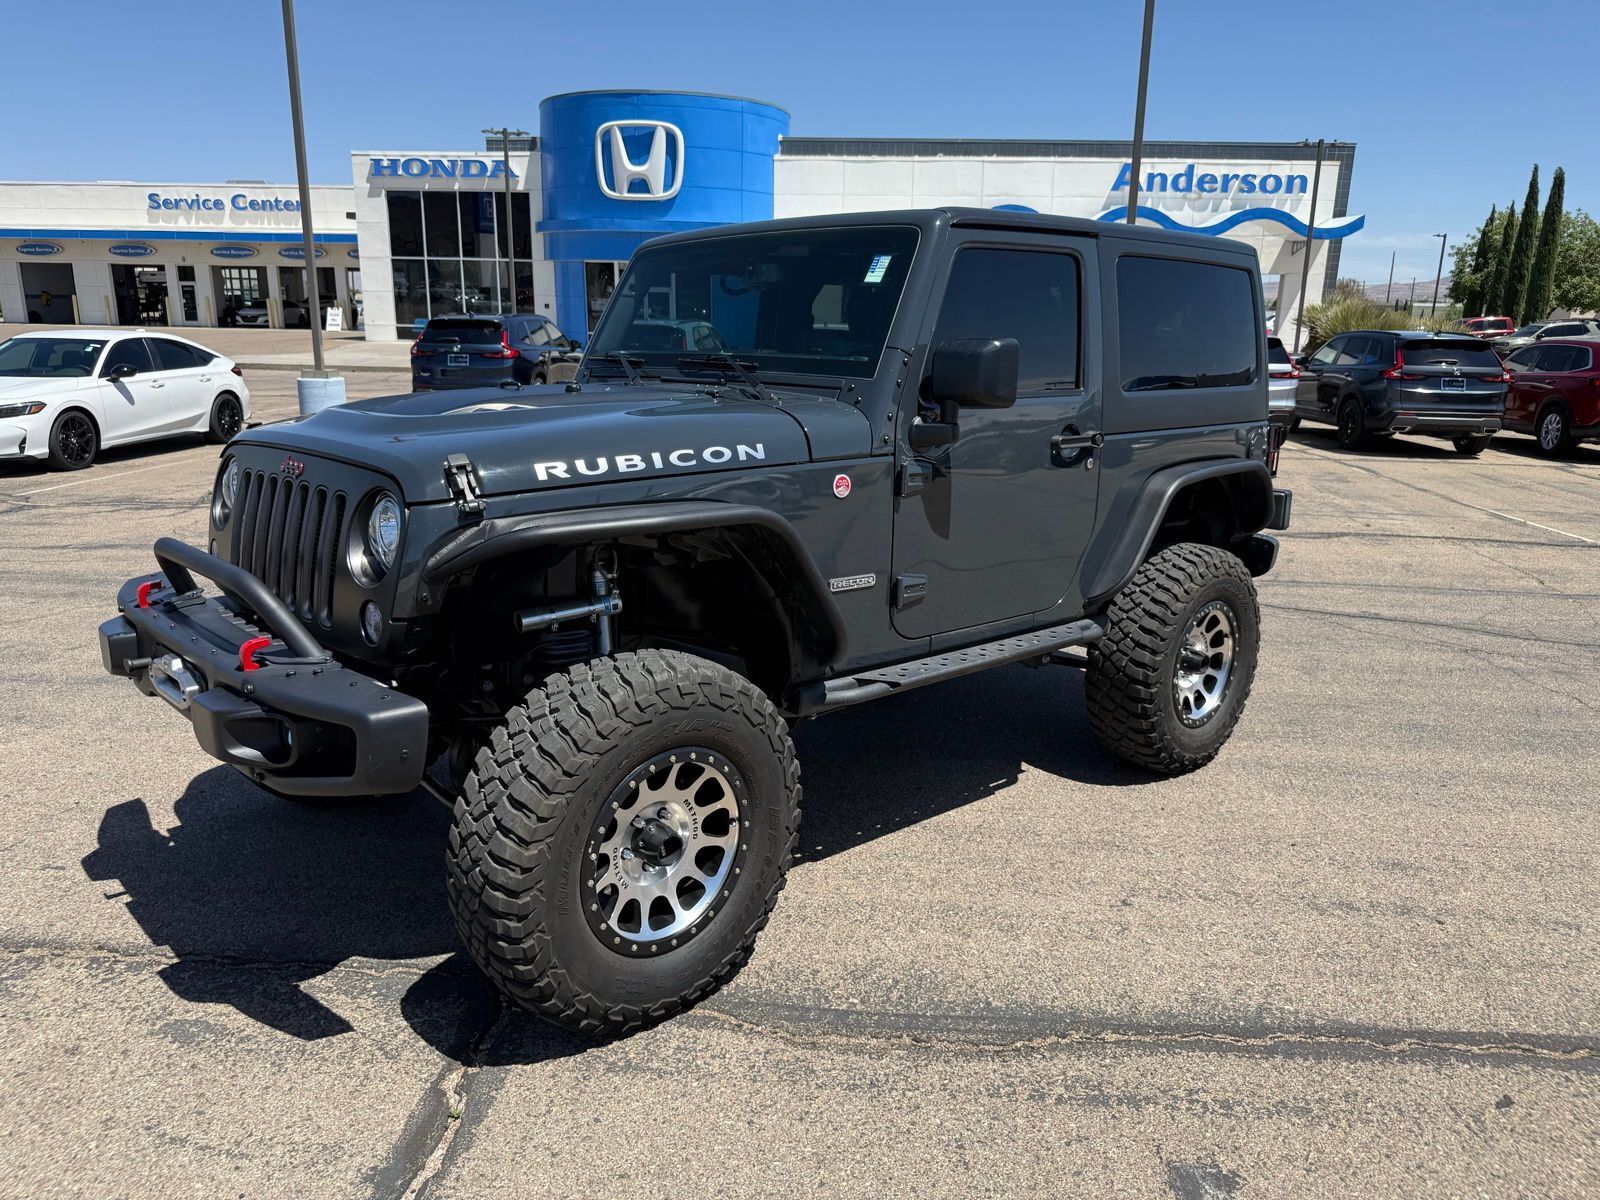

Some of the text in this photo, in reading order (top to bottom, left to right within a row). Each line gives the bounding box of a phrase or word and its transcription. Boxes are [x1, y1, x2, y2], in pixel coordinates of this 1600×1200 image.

[369, 158, 519, 179] HONDA
[1110, 163, 1308, 194] Anderson
[147, 193, 225, 211] Service
[533, 443, 766, 481] RUBICON
[682, 798, 699, 840] METHOD
[612, 847, 629, 890] METHOD
